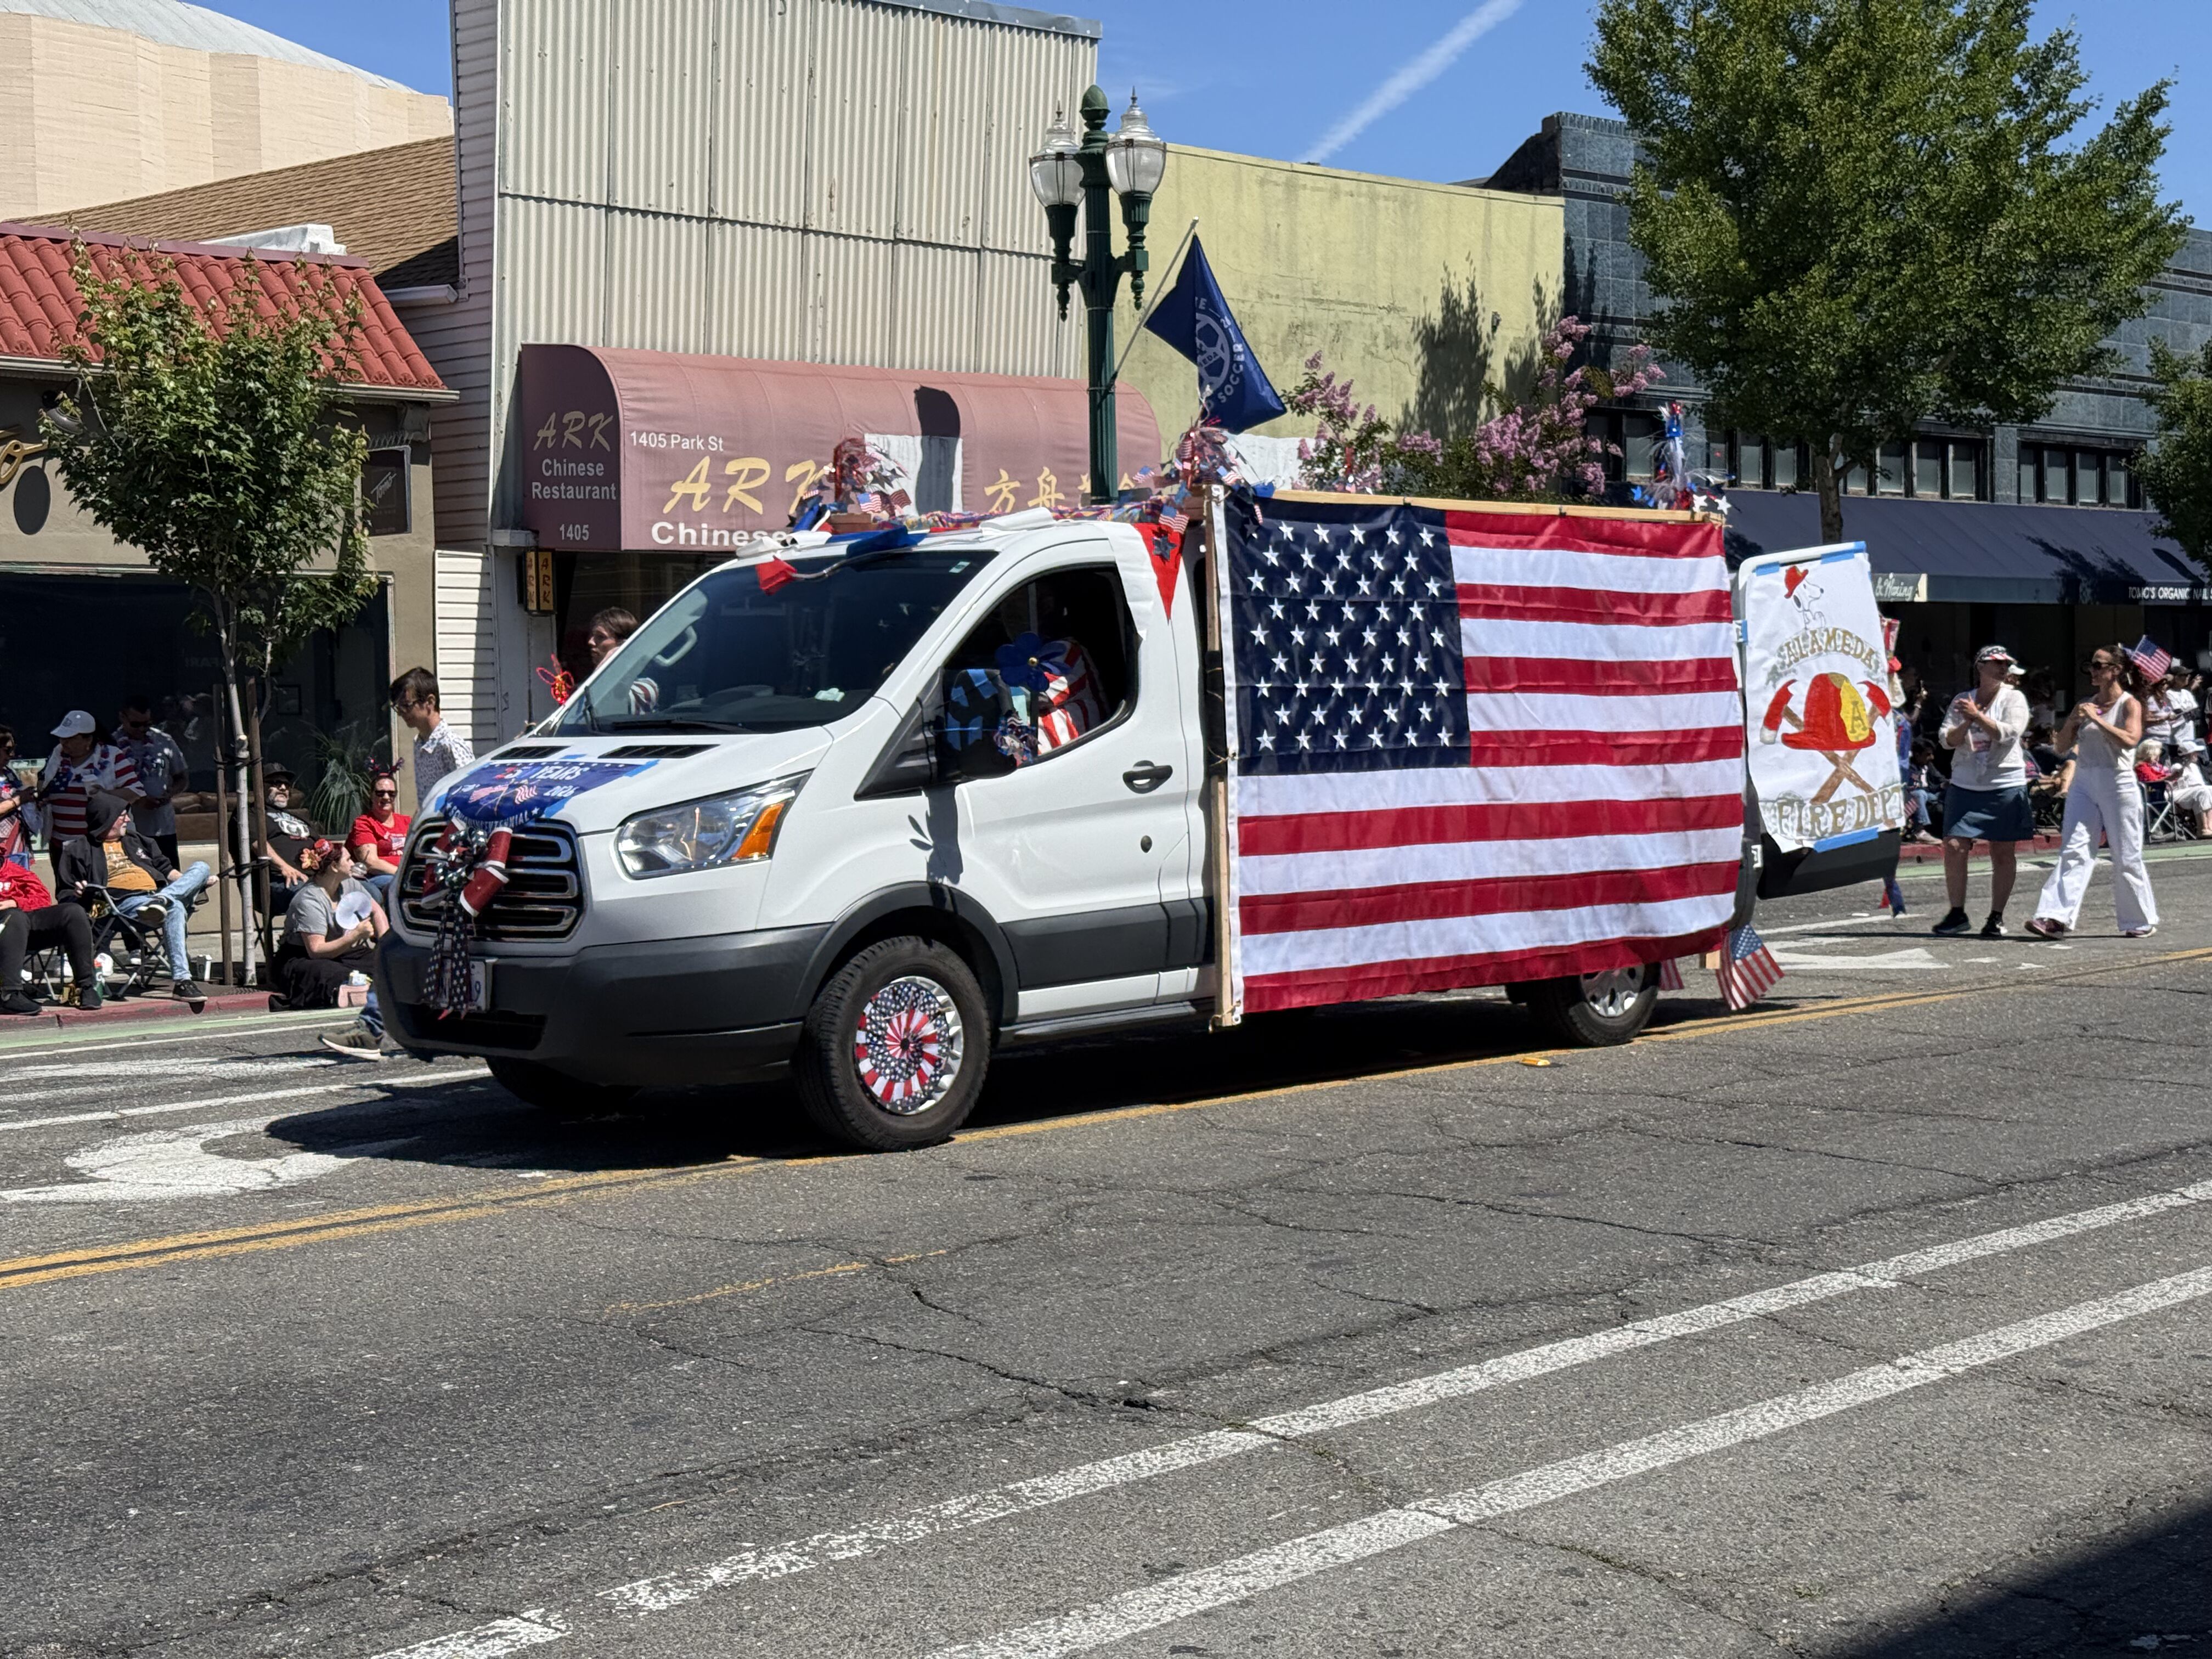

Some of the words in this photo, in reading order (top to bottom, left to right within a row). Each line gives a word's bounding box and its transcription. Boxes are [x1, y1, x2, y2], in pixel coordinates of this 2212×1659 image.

[1217, 343, 1245, 403] SOCCER
[533, 410, 614, 452] ARK
[630, 431, 668, 448] 1405
[670, 434, 705, 451] Park
[708, 436, 724, 452] St
[541, 458, 605, 477] Chinese
[532, 481, 616, 500] Restaurant
[560, 523, 590, 541] 1405
[540, 557, 551, 604] ARK
[1883, 577, 1914, 602] Waxing
[2158, 586, 2190, 601] ORGANIC
[2192, 587, 2209, 600] NAIL
[1784, 627, 1876, 670] ALAMEDA
[1848, 700, 1867, 733] A
[530, 765, 591, 780] YEARS
[1776, 798, 1847, 837] FIRE
[1852, 786, 1904, 830] DEPT
